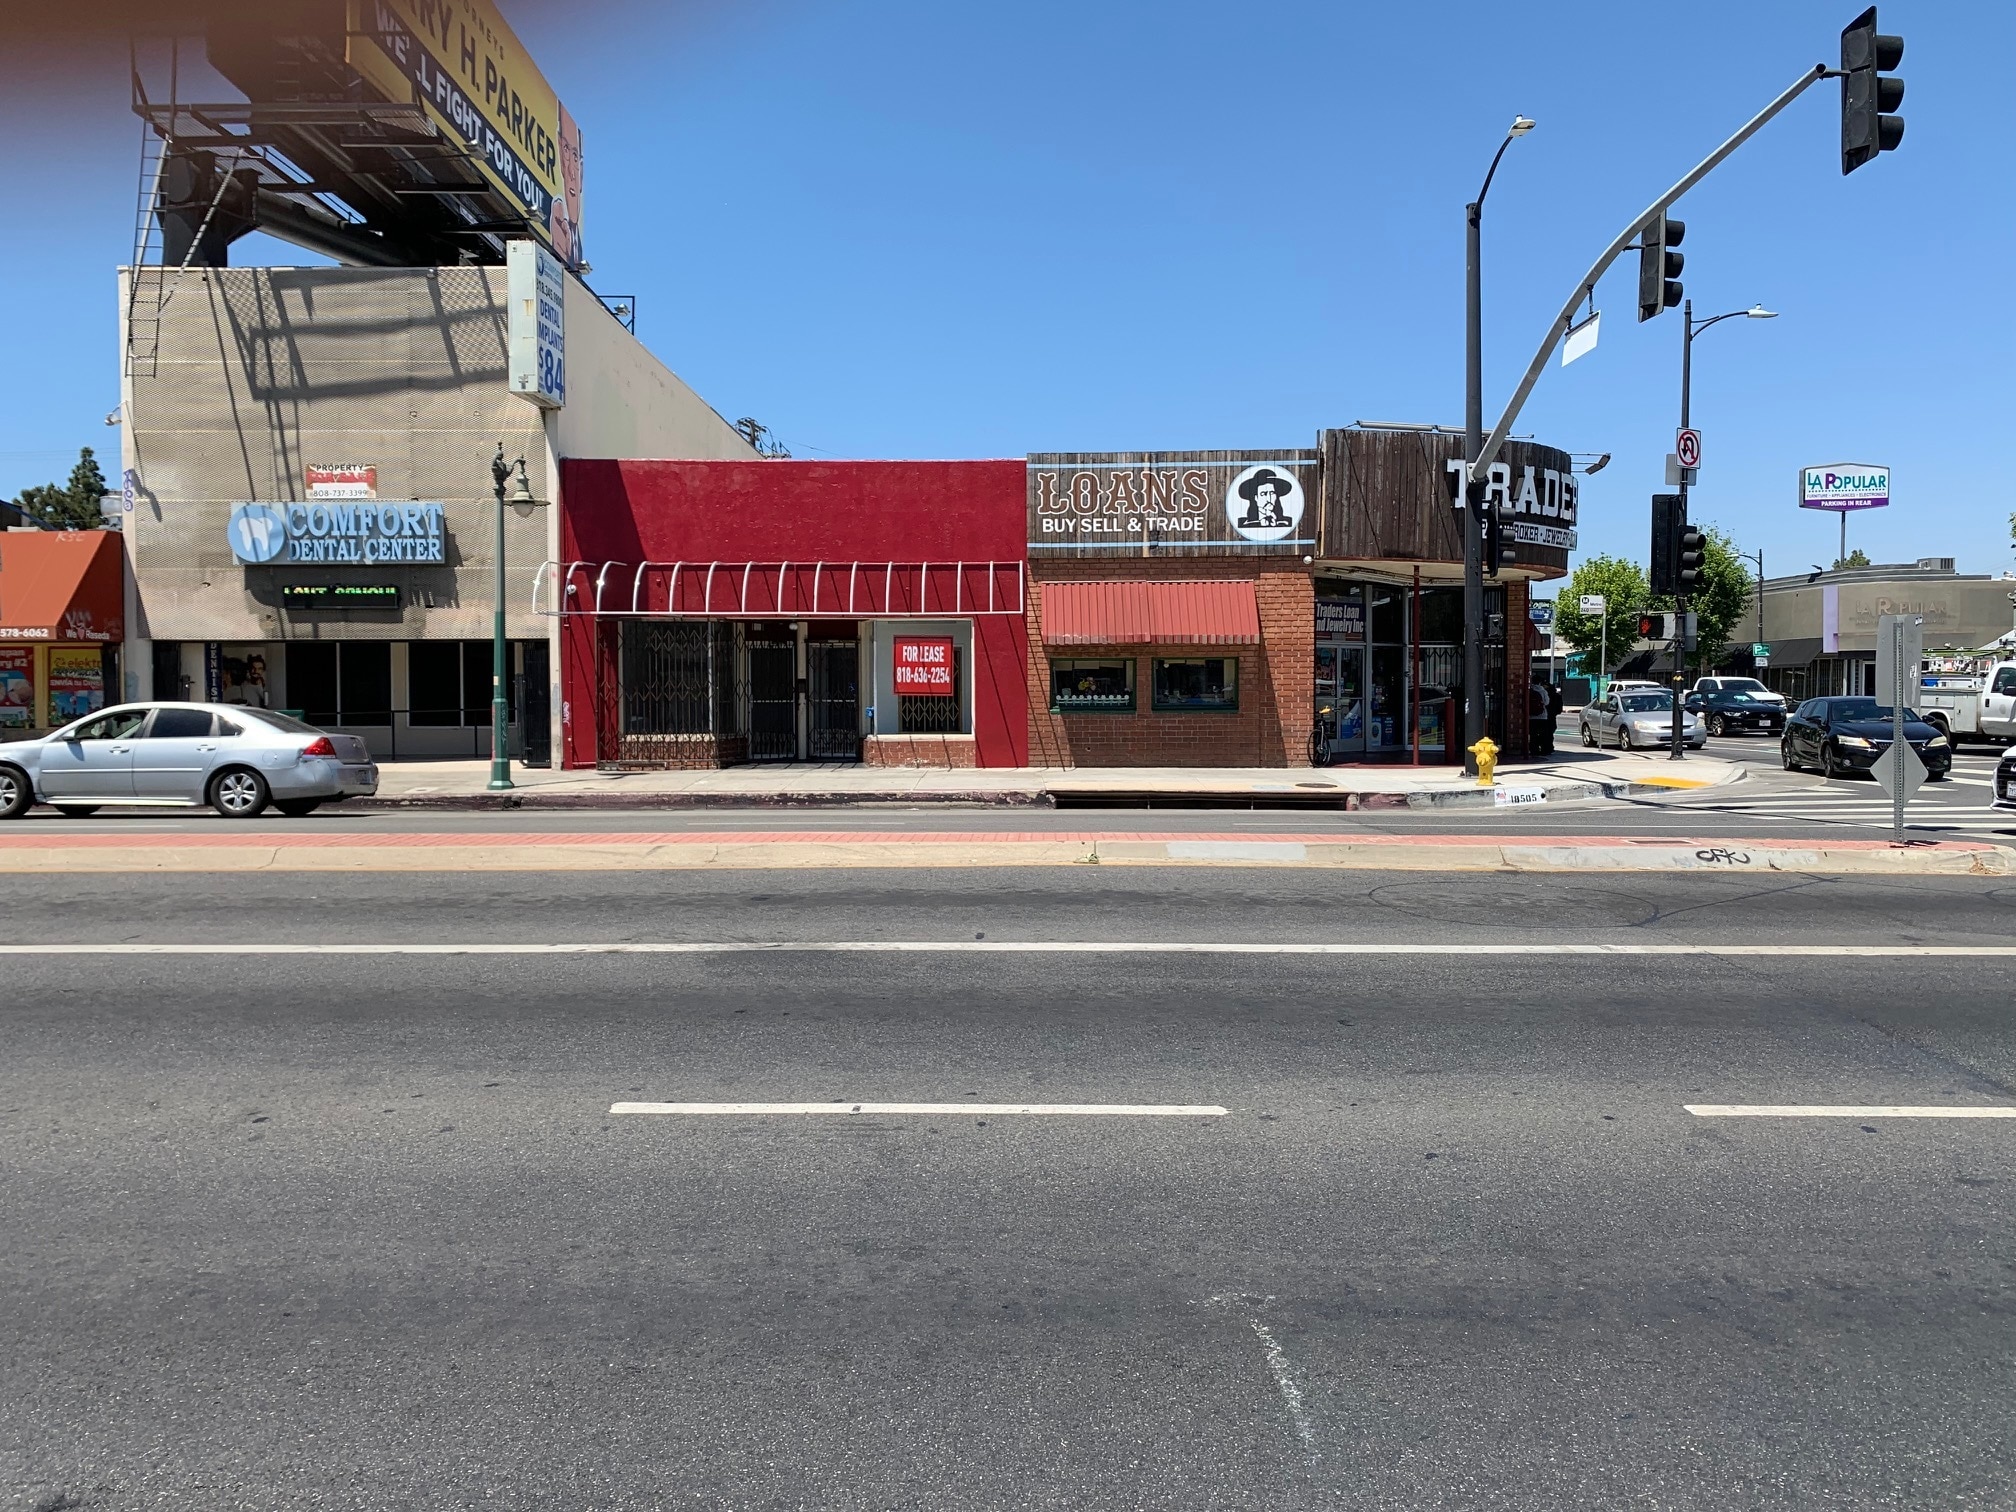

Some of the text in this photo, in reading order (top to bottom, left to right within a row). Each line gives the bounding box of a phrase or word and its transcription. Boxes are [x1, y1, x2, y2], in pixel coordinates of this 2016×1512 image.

[460, 22, 480, 92] H.
[485, 54, 557, 187] PARKER
[435, 70, 483, 141] FIGHT
[485, 127, 513, 183] FOR
[540, 298, 560, 329] DENTAL
[538, 320, 563, 354] MPLANTS
[316, 464, 364, 472] PROPERTY
[1807, 472, 1886, 490] LA POPULAR
[313, 489, 368, 497] 808-737-3399
[1037, 470, 1210, 515] LOANS
[285, 503, 444, 537] COMFORT
[1042, 516, 1204, 532] BUY SELL & TRADE
[287, 537, 443, 561] DENTAL CENTER
[1316, 603, 1360, 619] Traders Loan
[1316, 617, 1364, 634] nd Jewelry Inc
[902, 645, 945, 663] FOR LEASE
[896, 666, 950, 684] 818-636-2254
